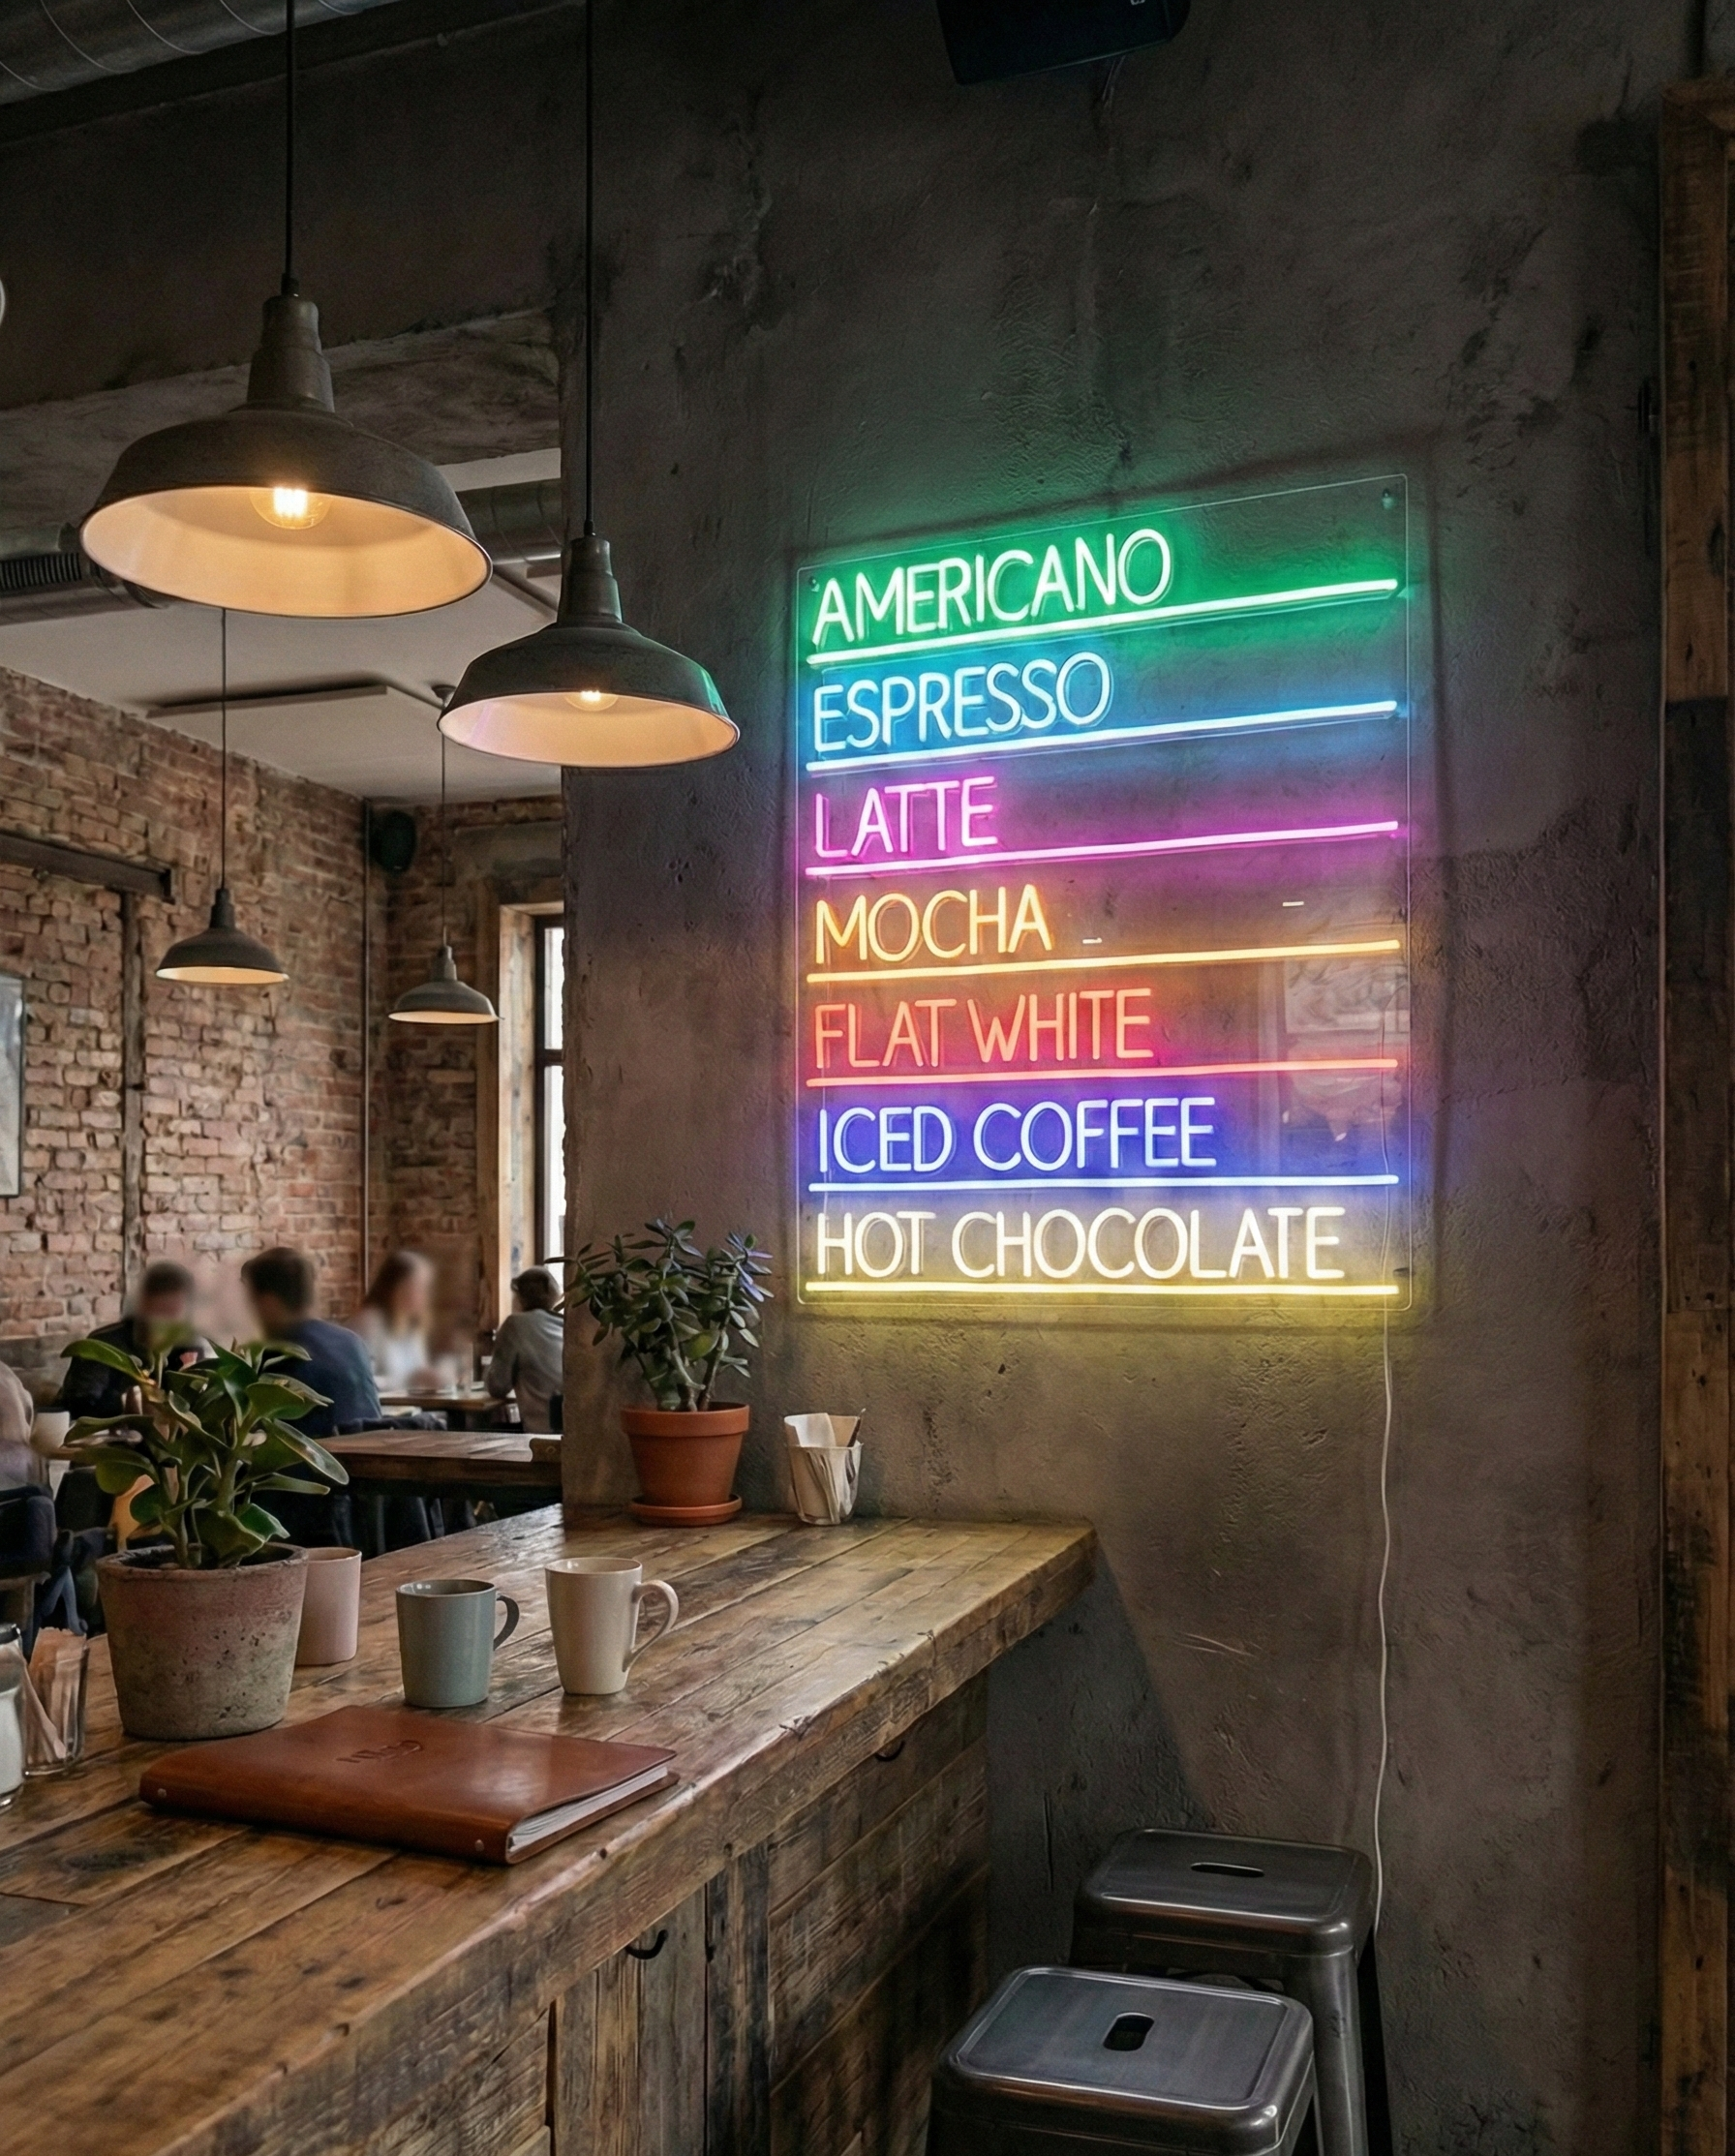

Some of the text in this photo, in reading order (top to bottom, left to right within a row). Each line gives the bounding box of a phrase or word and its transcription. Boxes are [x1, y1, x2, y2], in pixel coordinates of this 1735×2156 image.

[812, 528, 1172, 646] AMERICANO
[813, 652, 1111, 752] ESPRESSO
[814, 775, 998, 859] LATTE
[815, 884, 1053, 964] MOCHA
[814, 987, 1154, 1070] FLAT WHITE
[819, 1096, 1218, 1174] ICED COFFEE
[816, 1206, 1347, 1280] HOT CHOCOLATE
